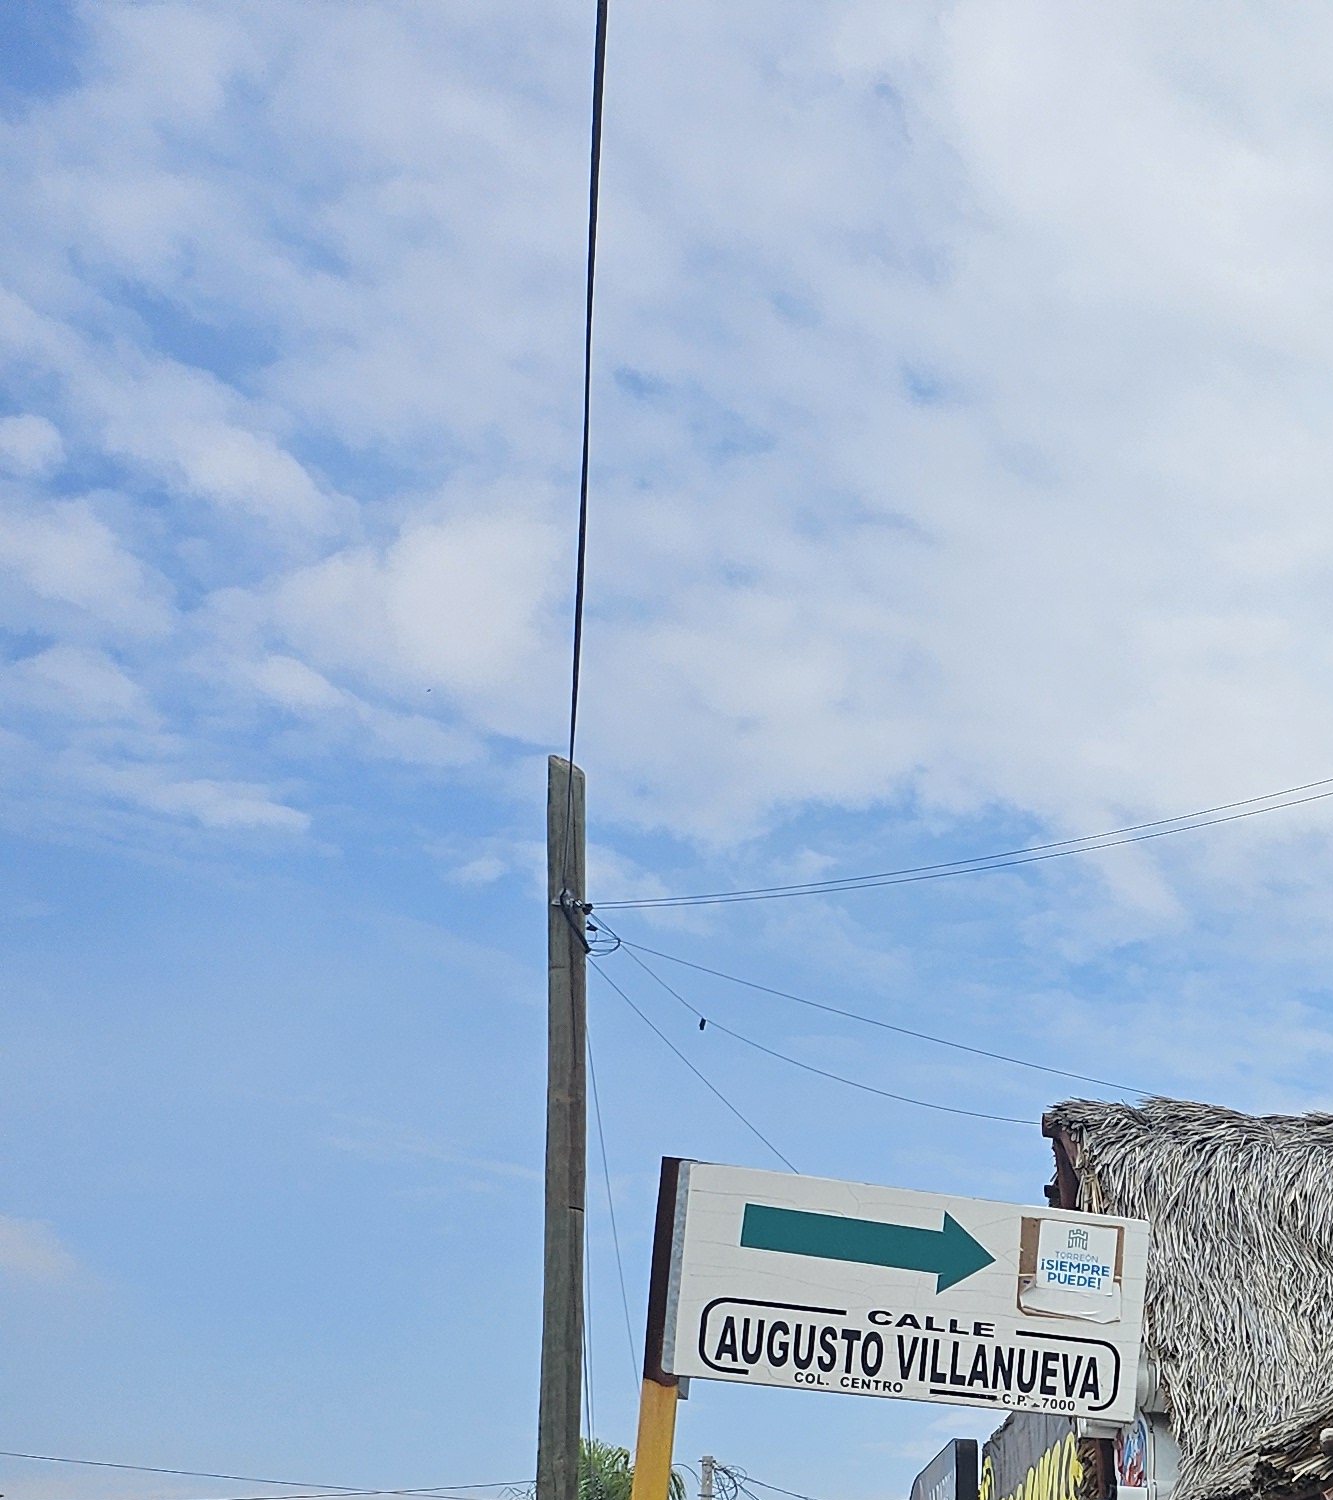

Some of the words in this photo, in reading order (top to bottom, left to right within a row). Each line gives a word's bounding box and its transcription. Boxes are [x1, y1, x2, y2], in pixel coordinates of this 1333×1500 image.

[1041, 1259, 1110, 1277] ¡SIEMPRE
[1055, 1251, 1099, 1263] TORREÓN
[1047, 1272, 1102, 1290] PUEDE!
[867, 1310, 995, 1338] CALLE
[715, 1316, 884, 1379] AUGUSTO
[896, 1335, 1101, 1401] VILLANUEVA
[794, 1371, 830, 1387] COL.
[840, 1376, 904, 1394] CENTRO
[1002, 1393, 1028, 1408] C.P.
